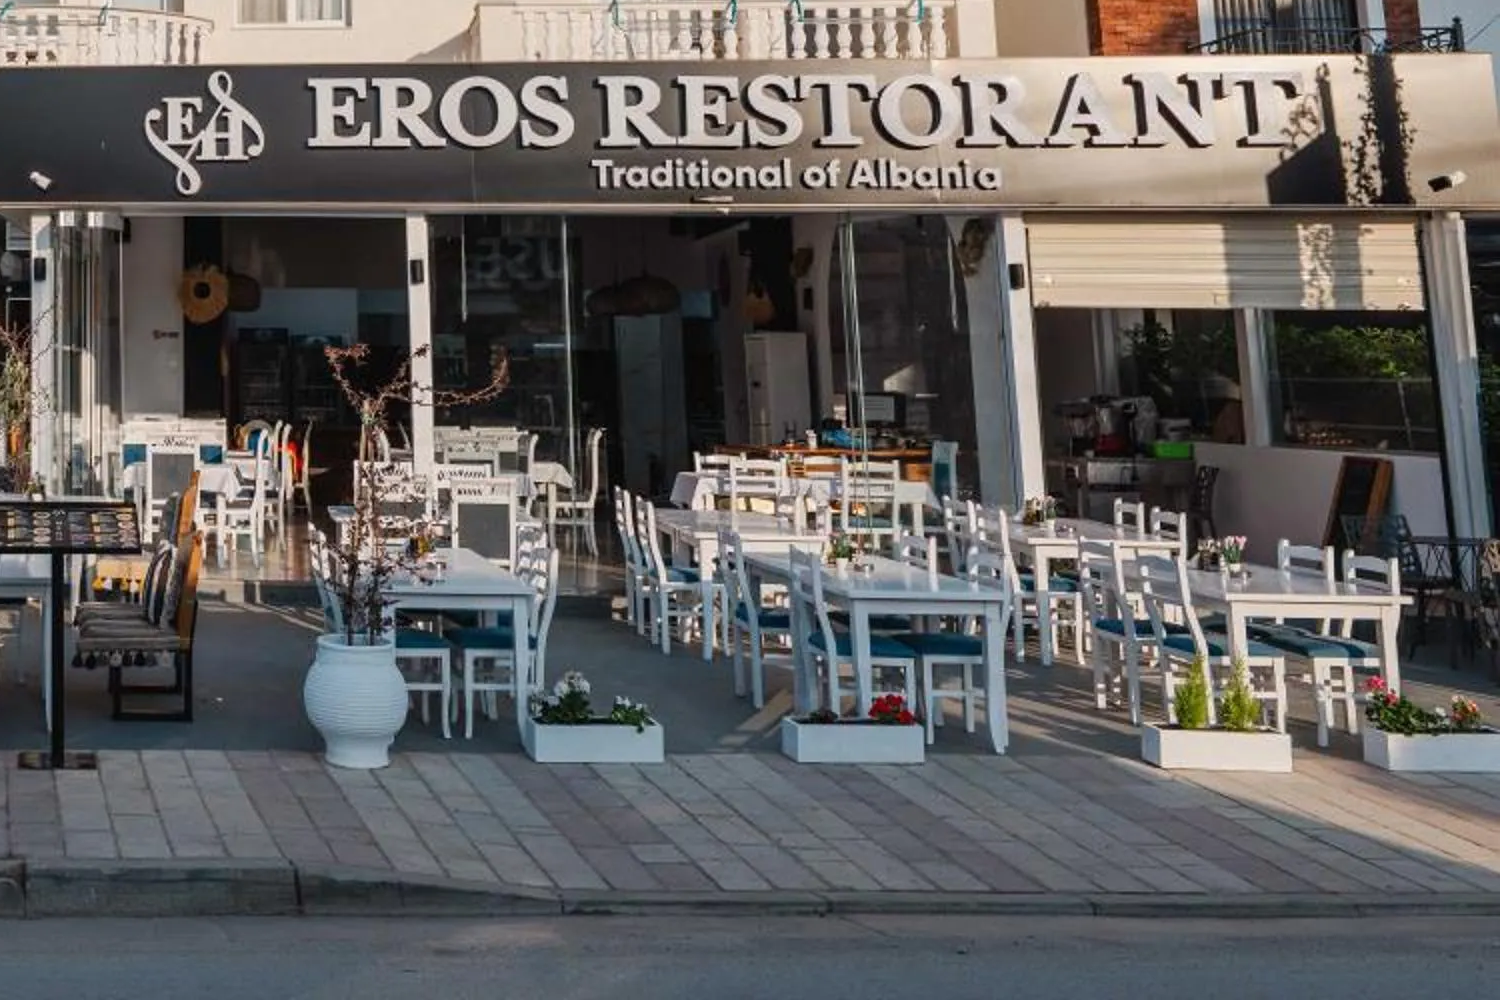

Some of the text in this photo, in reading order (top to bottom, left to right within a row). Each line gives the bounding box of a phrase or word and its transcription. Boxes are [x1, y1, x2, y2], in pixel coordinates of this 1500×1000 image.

[305, 70, 1303, 149] EROS RESTORANT
[591, 157, 1002, 190] Traditional of Albania
